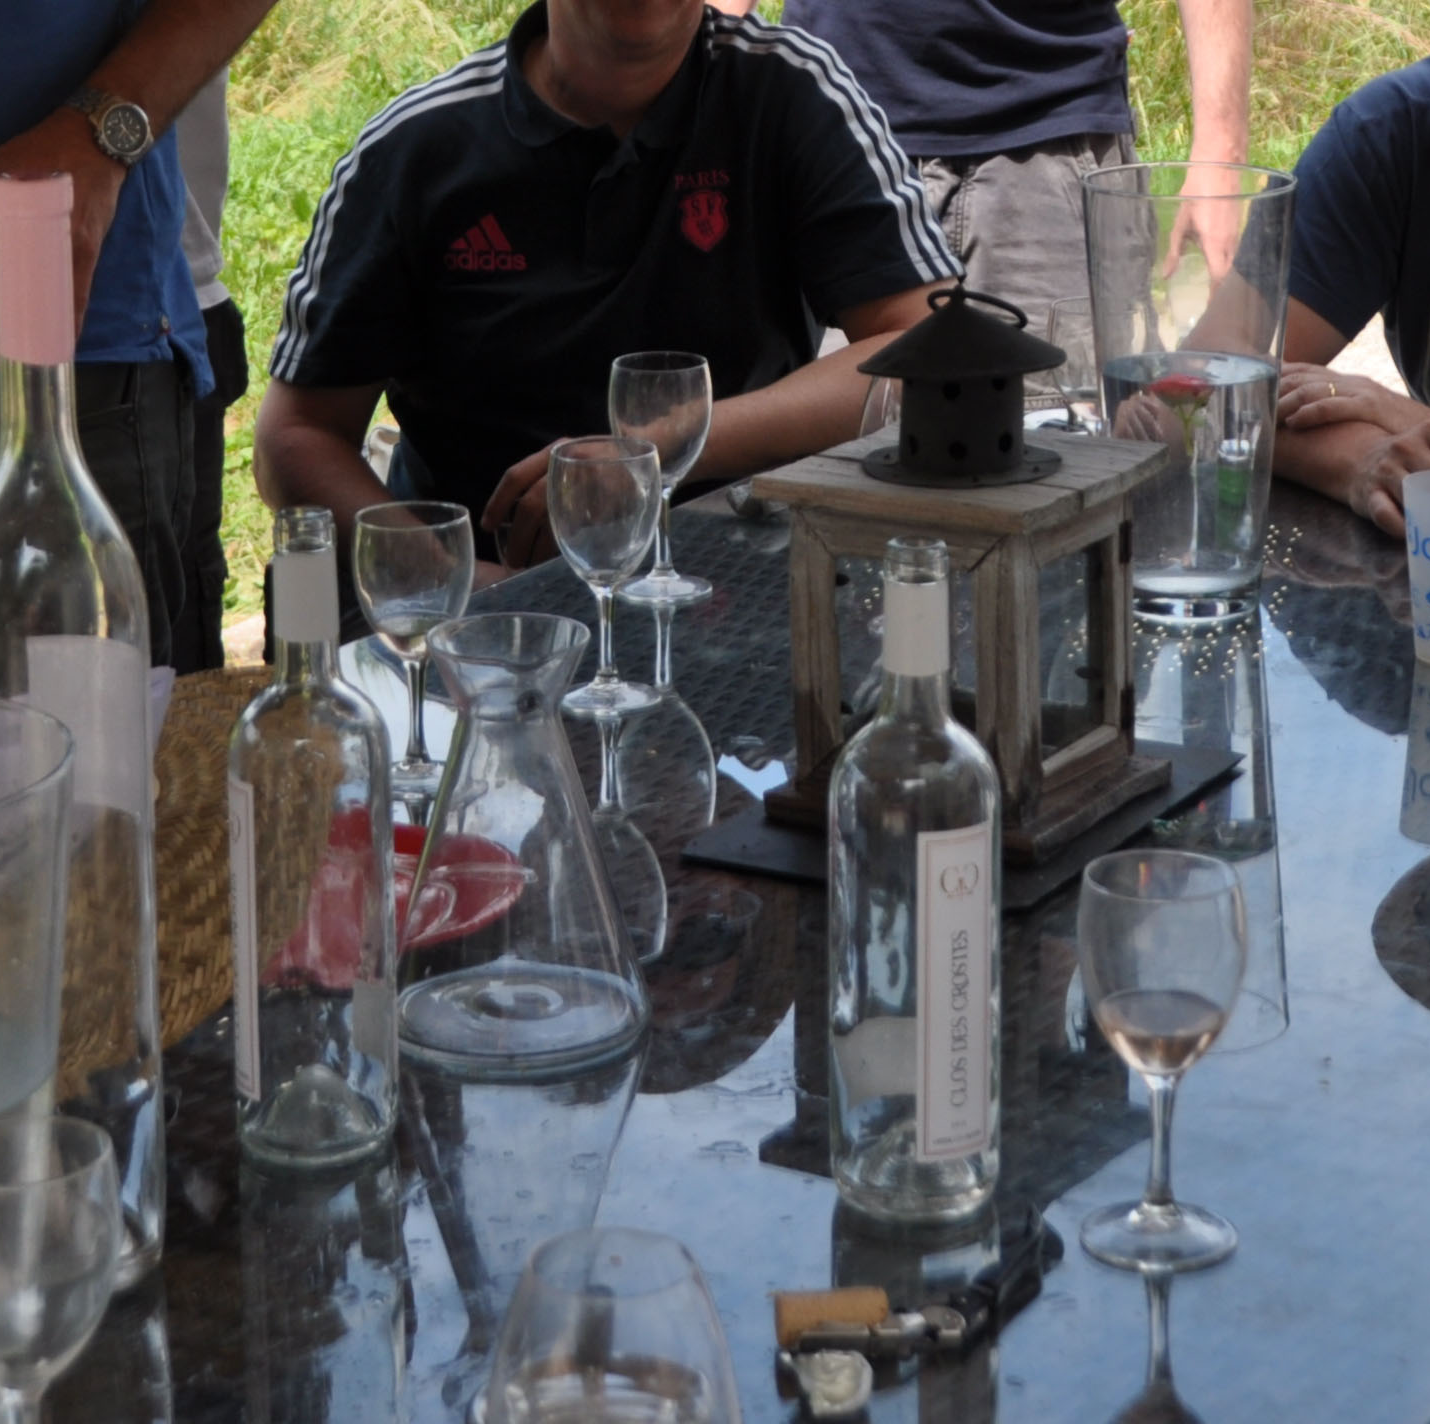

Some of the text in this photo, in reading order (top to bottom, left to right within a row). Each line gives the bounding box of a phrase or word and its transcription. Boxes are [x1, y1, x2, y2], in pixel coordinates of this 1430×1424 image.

[674, 168, 730, 190] PARIS
[444, 248, 527, 272] adidas
[950, 929, 969, 1012] CROSTES
[950, 1016, 968, 1052] DES
[950, 1056, 968, 1108] CLOS
